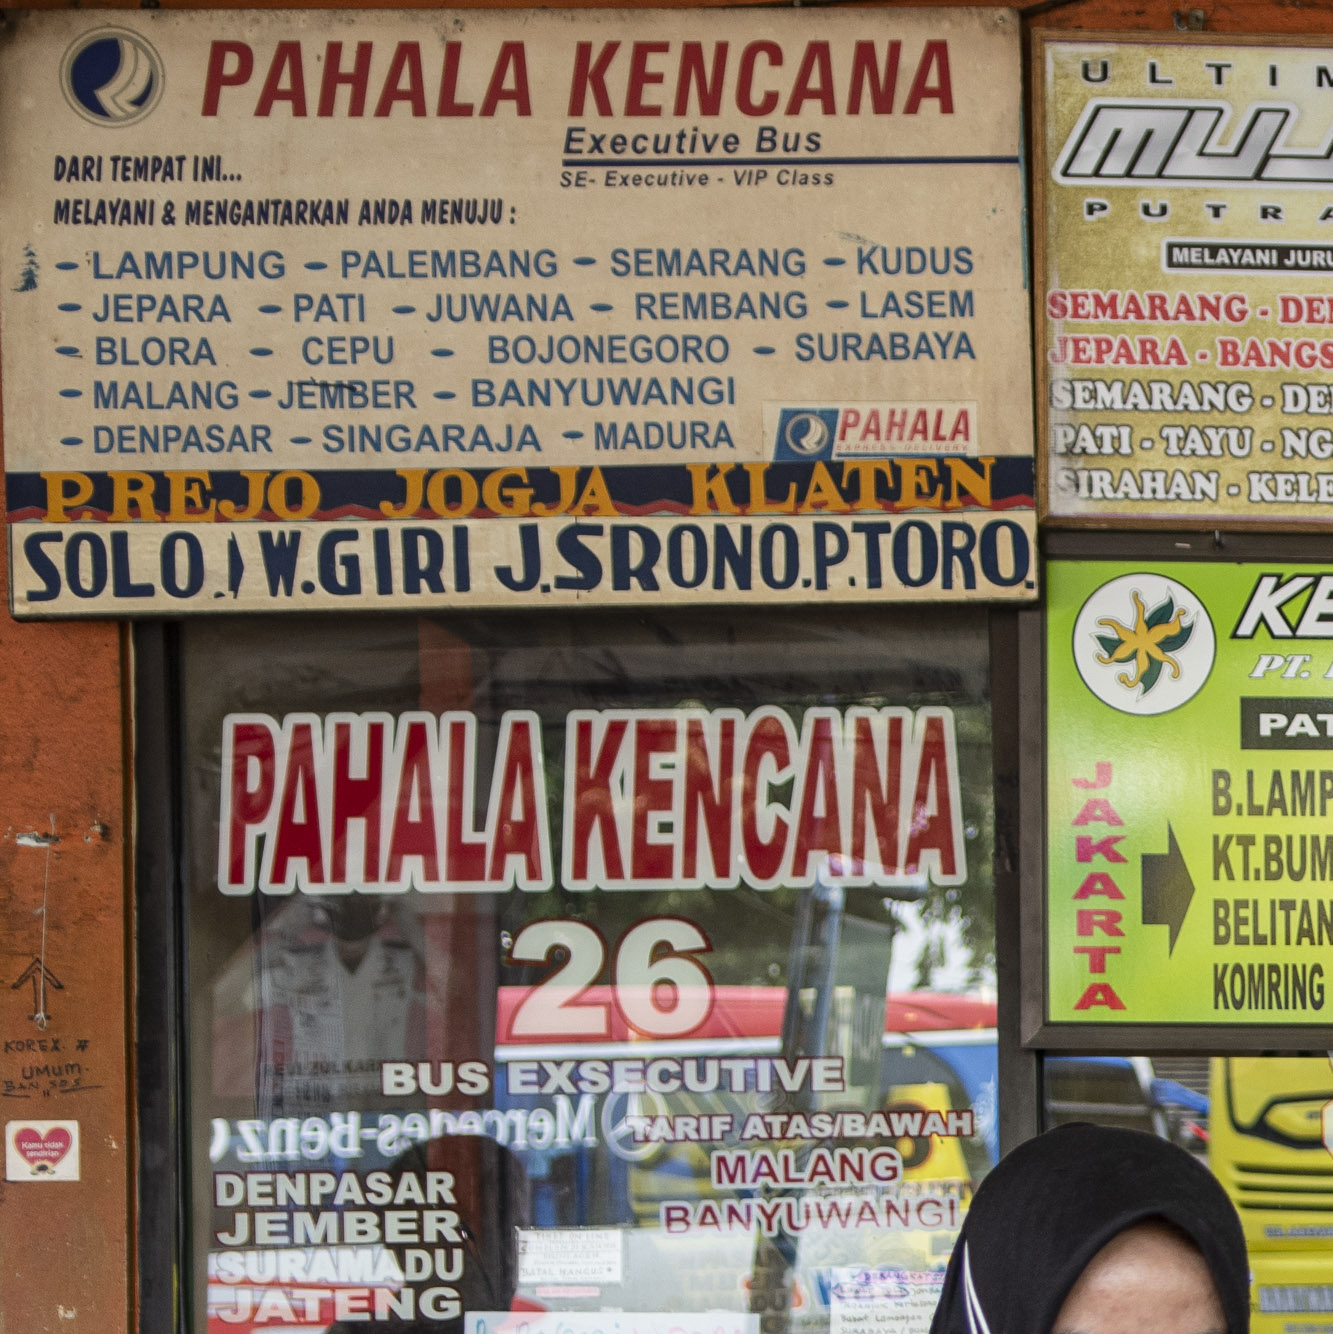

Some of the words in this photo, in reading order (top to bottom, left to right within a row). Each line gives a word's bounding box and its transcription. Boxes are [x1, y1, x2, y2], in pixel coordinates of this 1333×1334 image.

[201, 41, 532, 118] PAHALA
[568, 40, 956, 117] KENCANA
[564, 127, 739, 157] Executive
[755, 126, 822, 154] Bus
[54, 156, 102, 183] DARI
[110, 155, 185, 183] TEMPAT
[192, 156, 242, 183] INI...
[605, 170, 711, 190] Executive
[734, 169, 773, 188] VIP
[781, 168, 835, 187] Class
[54, 199, 155, 225] MELAYANI
[161, 200, 176, 224] &
[185, 199, 350, 226] MENGANTARKAN
[358, 198, 412, 225] ANDA
[420, 198, 503, 225] MENUJU
[93, 251, 286, 279] LAMPUNG
[341, 250, 557, 278] PALEMBANG
[610, 248, 806, 277] SEMARANG
[856, 246, 974, 277] KUDUS
[1173, 247, 1278, 269] MELAYANI
[1048, 291, 1249, 326] SEMARANG
[838, 408, 971, 442] PAHALA
[219, 711, 553, 895] PAHALA
[562, 706, 967, 890] KENCANA
[1070, 760, 1129, 1011] JAKARTA
[507, 917, 714, 1041] 26
[1214, 964, 1324, 1010] KOMRING
[381, 1061, 490, 1096] BUS
[507, 1057, 845, 1094] EXSECUTIVE
[627, 1114, 737, 1142] TARIF
[743, 1110, 974, 1139] ATAS/BAWAH
[711, 1148, 903, 1189] MALANG
[214, 1171, 456, 1206] DENPASAR
[216, 1211, 461, 1246] JEMBER
